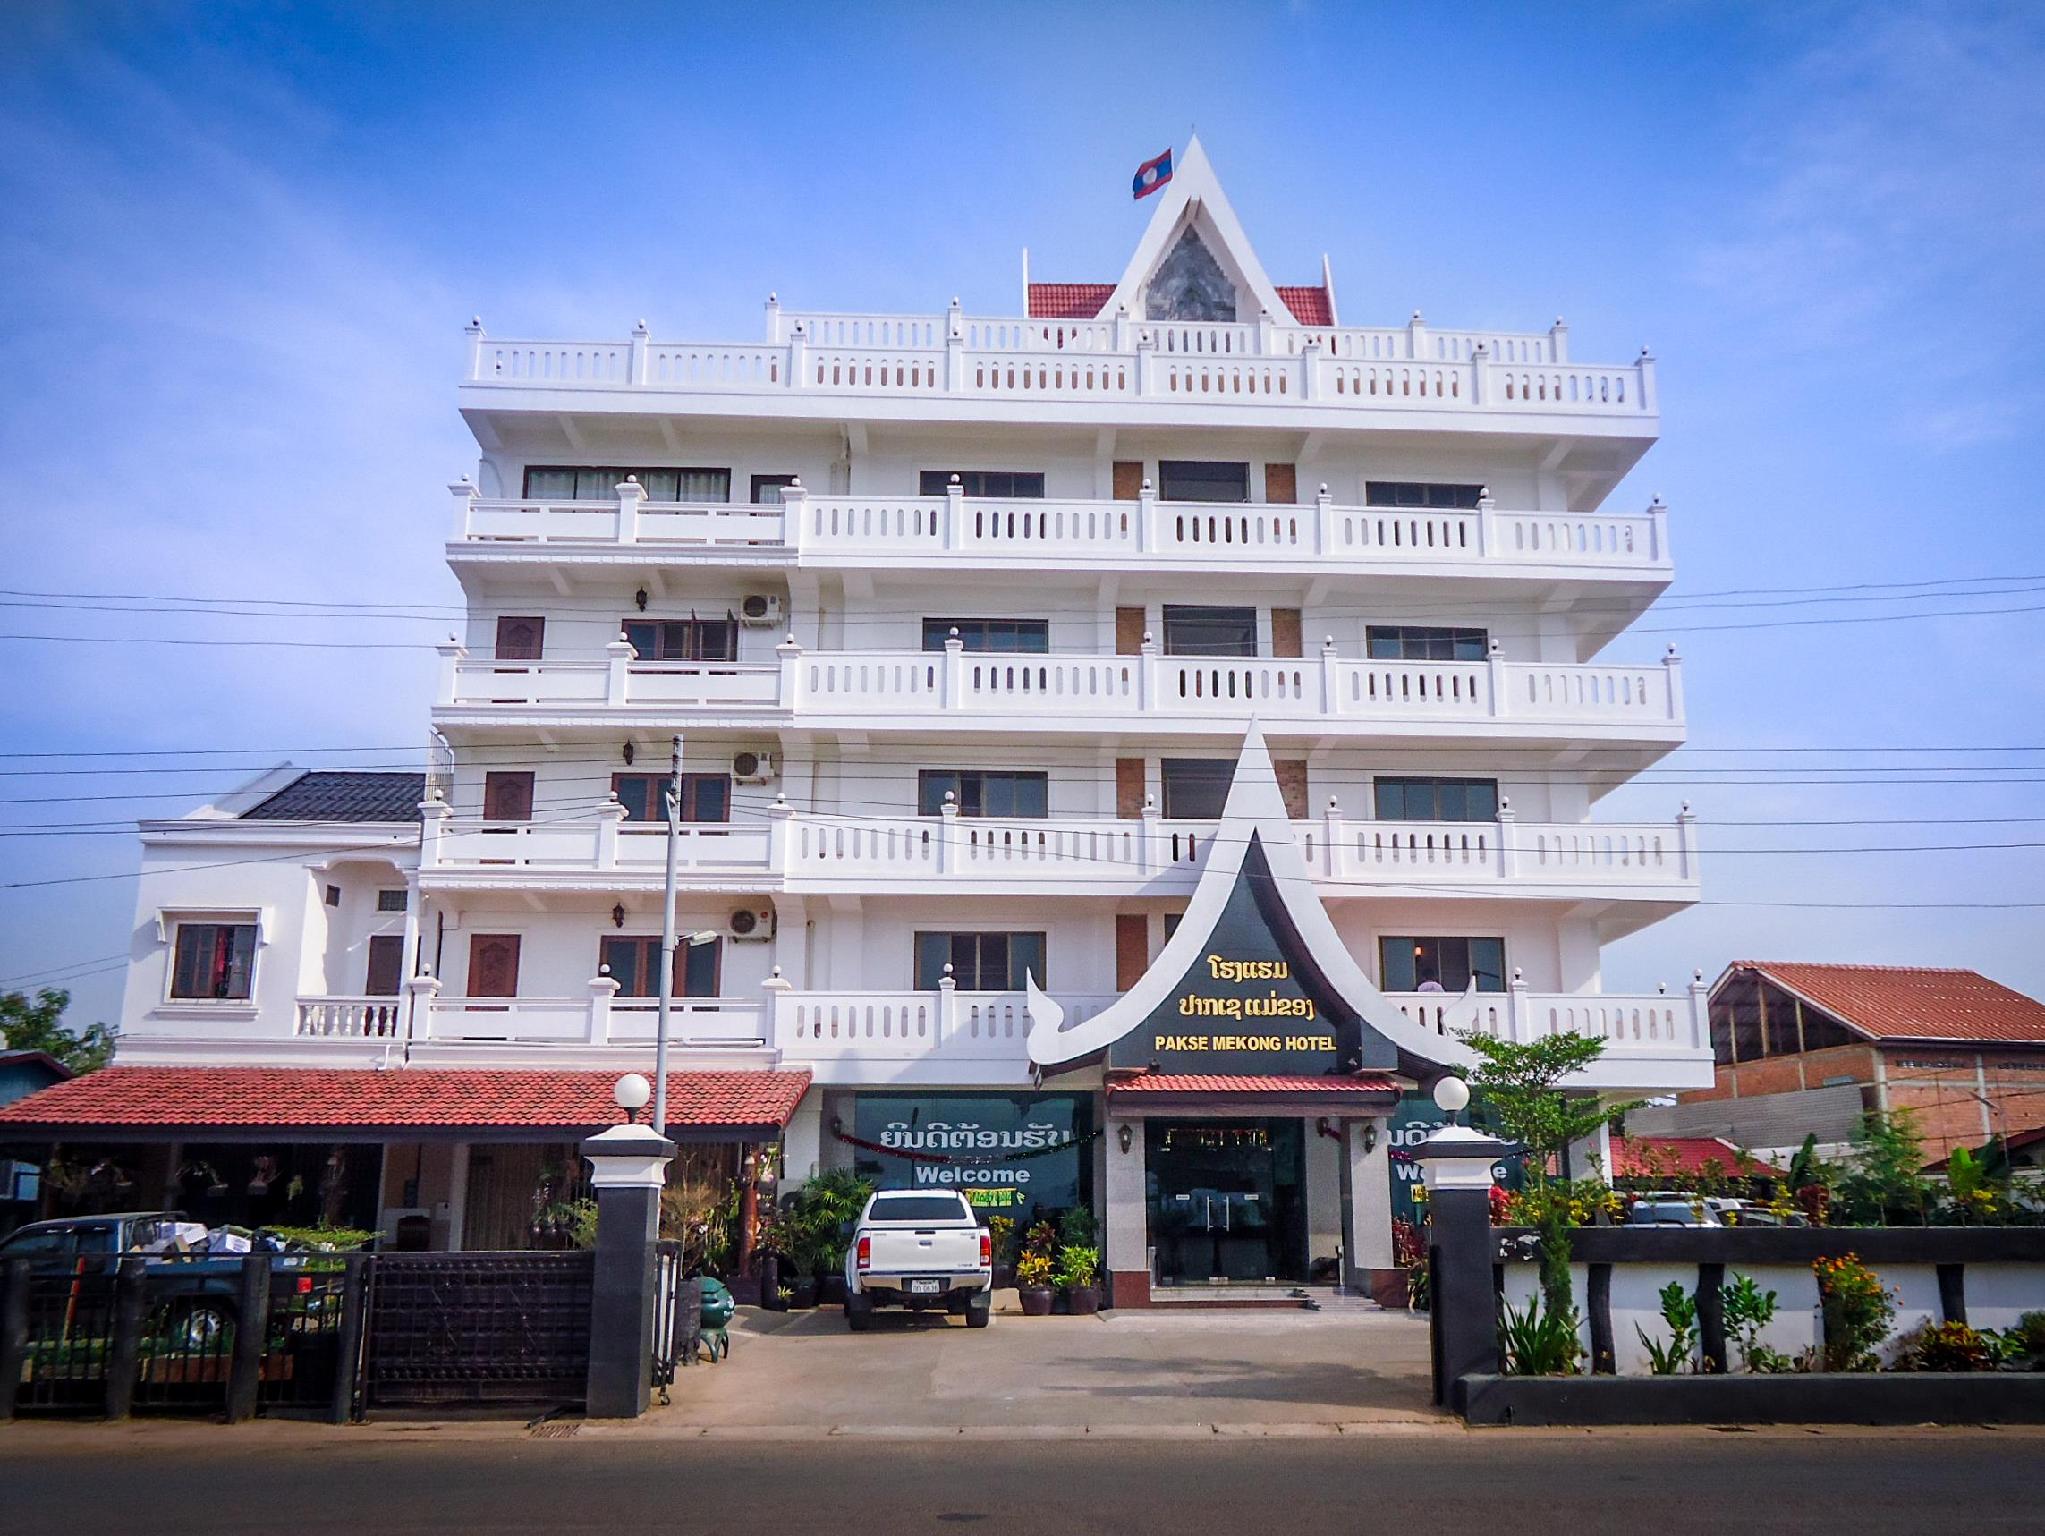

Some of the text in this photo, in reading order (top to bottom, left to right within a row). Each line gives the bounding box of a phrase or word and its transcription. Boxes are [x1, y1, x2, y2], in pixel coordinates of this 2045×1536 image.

[1207, 954, 1288, 982] ໂຮງແຮມ
[1244, 990, 1317, 1022] ແມ່ຂອງ
[1155, 1036, 1337, 1051] PAKSE MEKONG HOTEL
[915, 1166, 1031, 1183] Welcome
